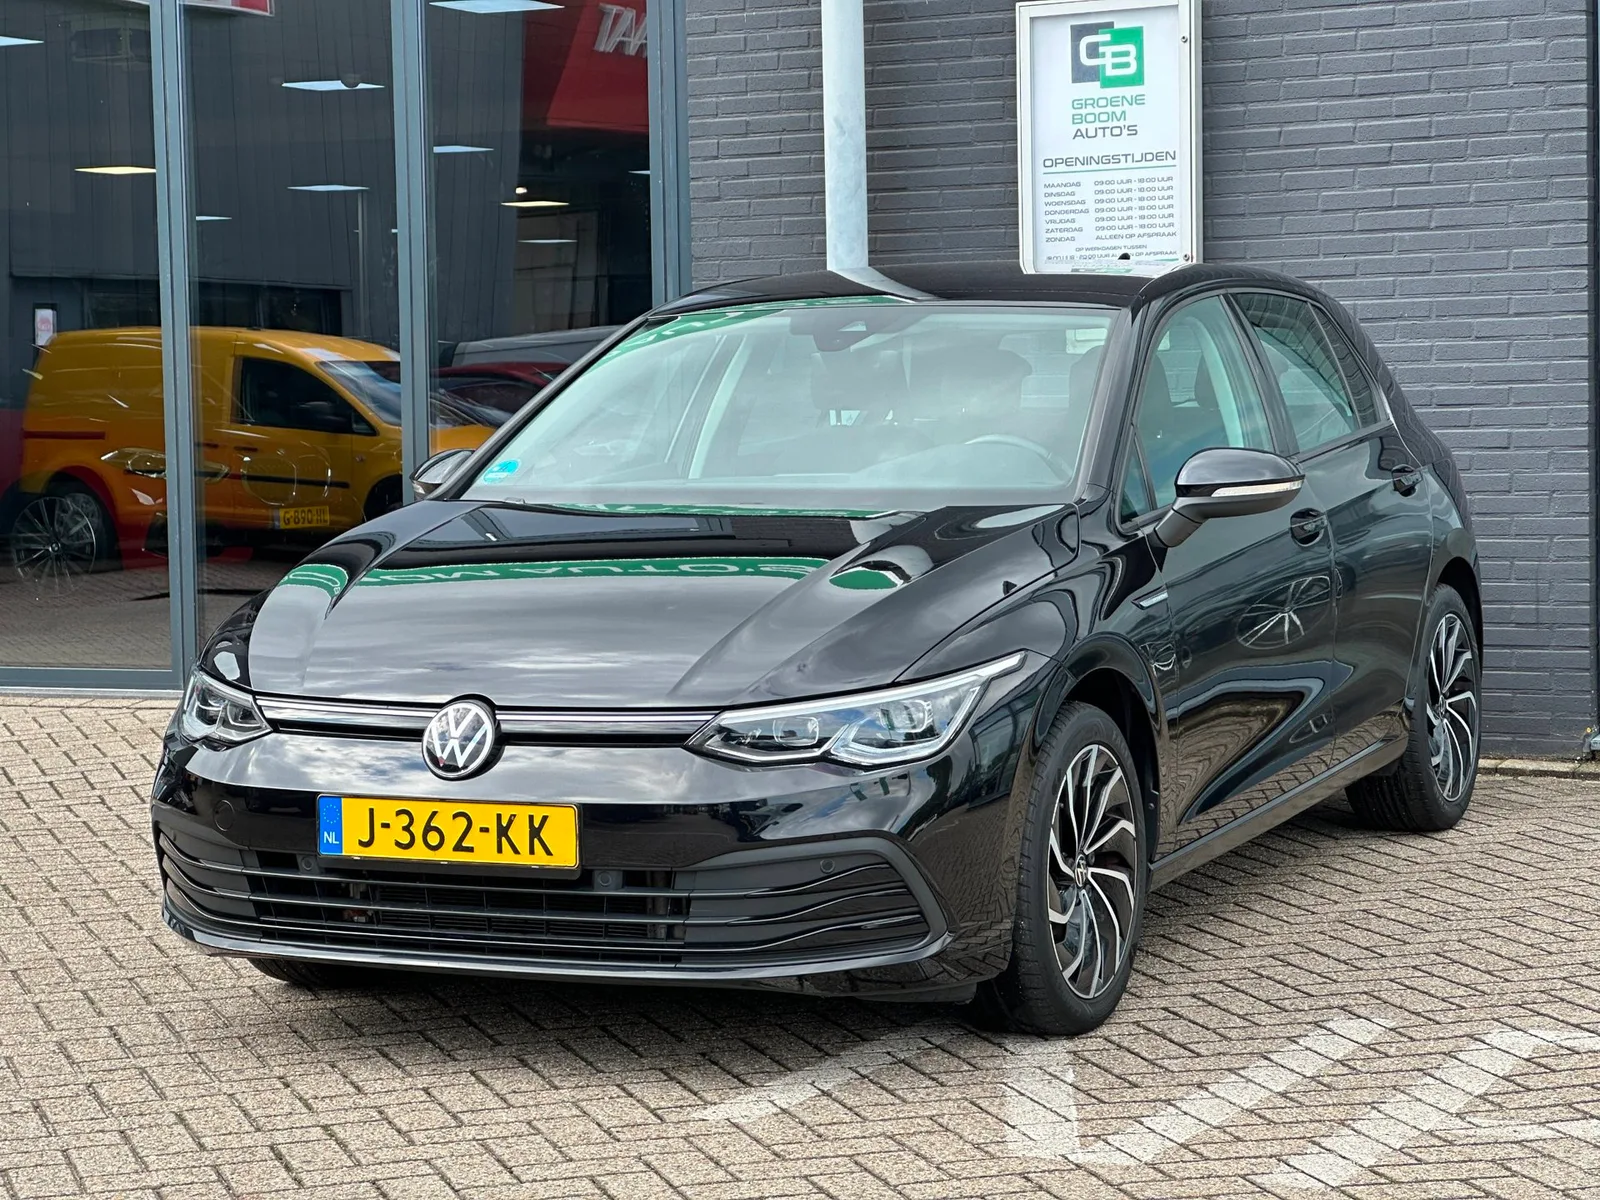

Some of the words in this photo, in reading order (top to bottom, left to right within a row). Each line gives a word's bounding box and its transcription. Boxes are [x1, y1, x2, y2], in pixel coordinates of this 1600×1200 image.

[1072, 94, 1146, 110] GROENE
[1072, 110, 1127, 125] BOOM
[1072, 124, 1138, 140] AUTO'S
[1043, 150, 1176, 168] OPENINGSTIJDEN
[324, 831, 339, 844] NL
[358, 808, 554, 856] J-362-KK
